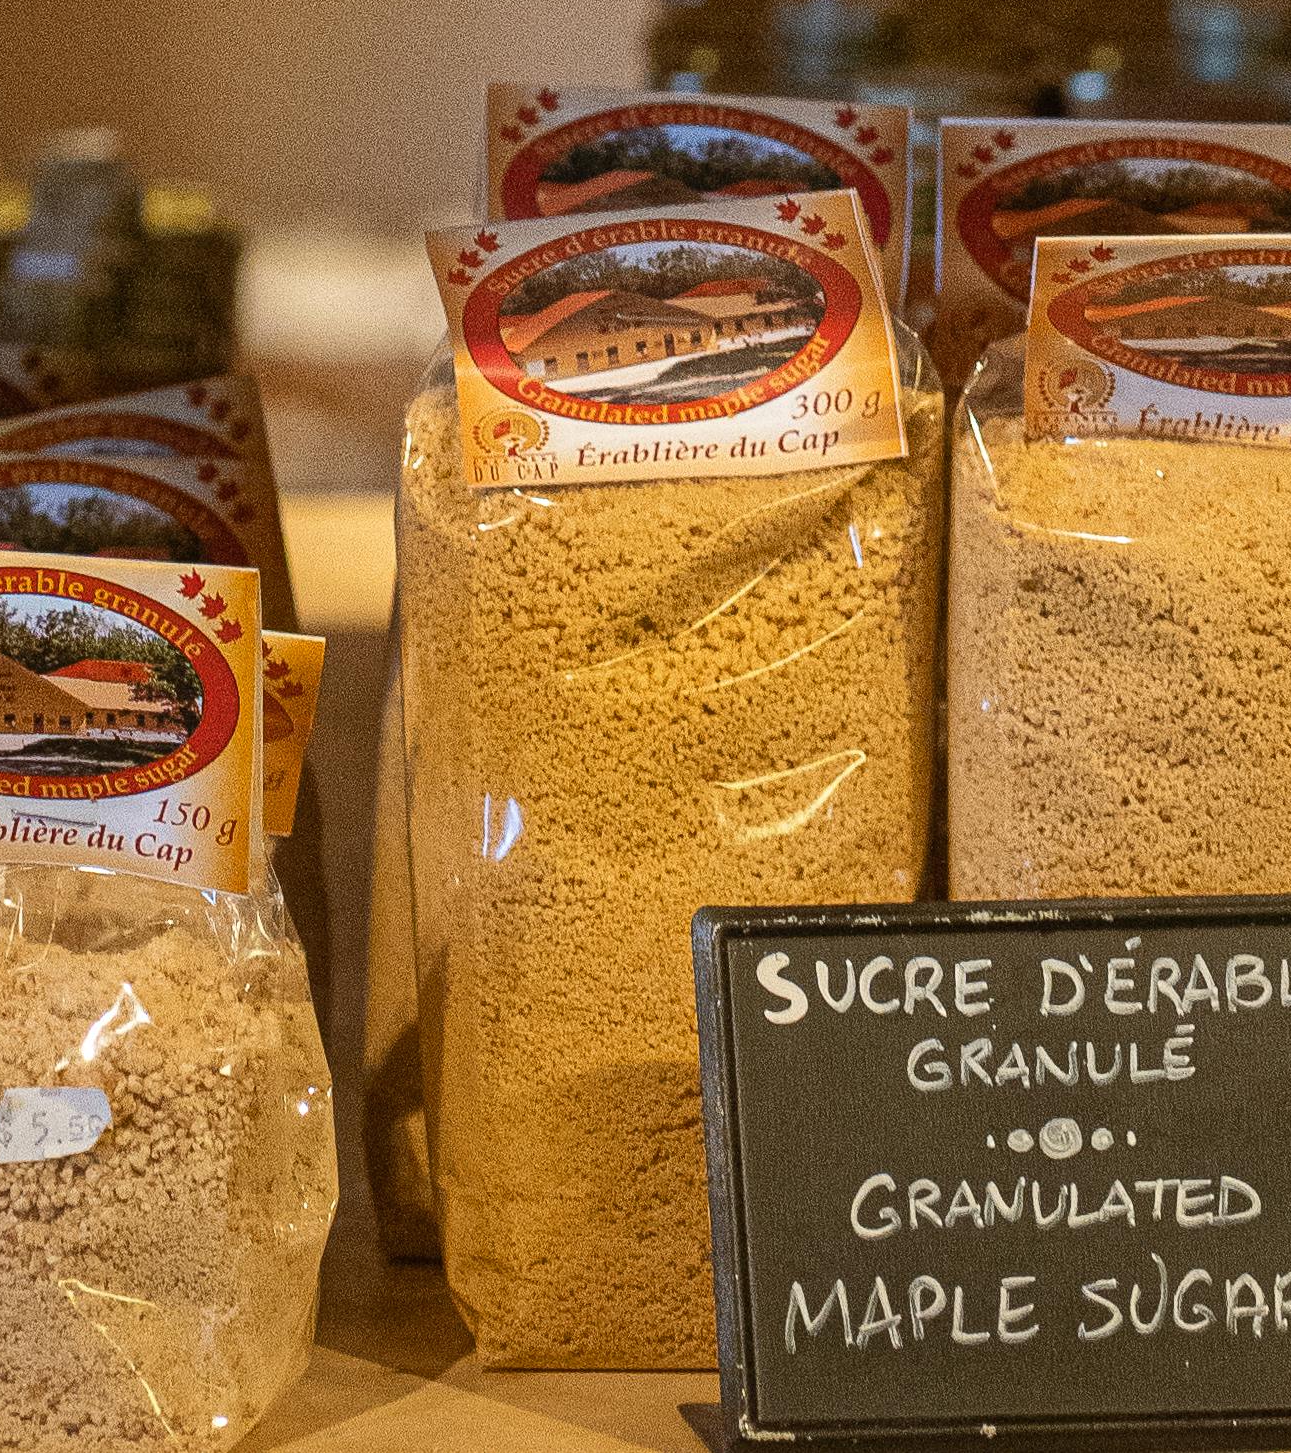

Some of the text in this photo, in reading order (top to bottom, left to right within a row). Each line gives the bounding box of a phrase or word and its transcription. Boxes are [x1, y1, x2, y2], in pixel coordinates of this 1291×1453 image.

[517, 335, 832, 426] Granulated maple sugar
[791, 388, 882, 423] 300 g
[576, 428, 841, 469] Érablière du Cap
[92, 586, 204, 660] granulé
[39, 775, 130, 804] maple
[135, 743, 199, 792] sugar
[86, 824, 127, 852] du
[134, 834, 194, 872] Cap
[153, 798, 237, 846] 150 g
[754, 951, 994, 1026] SUCRE
[906, 1022, 1197, 1093] GRANULÉ
[849, 1172, 1263, 1241] GRANULATED
[785, 1274, 1043, 1354] MAPLE
